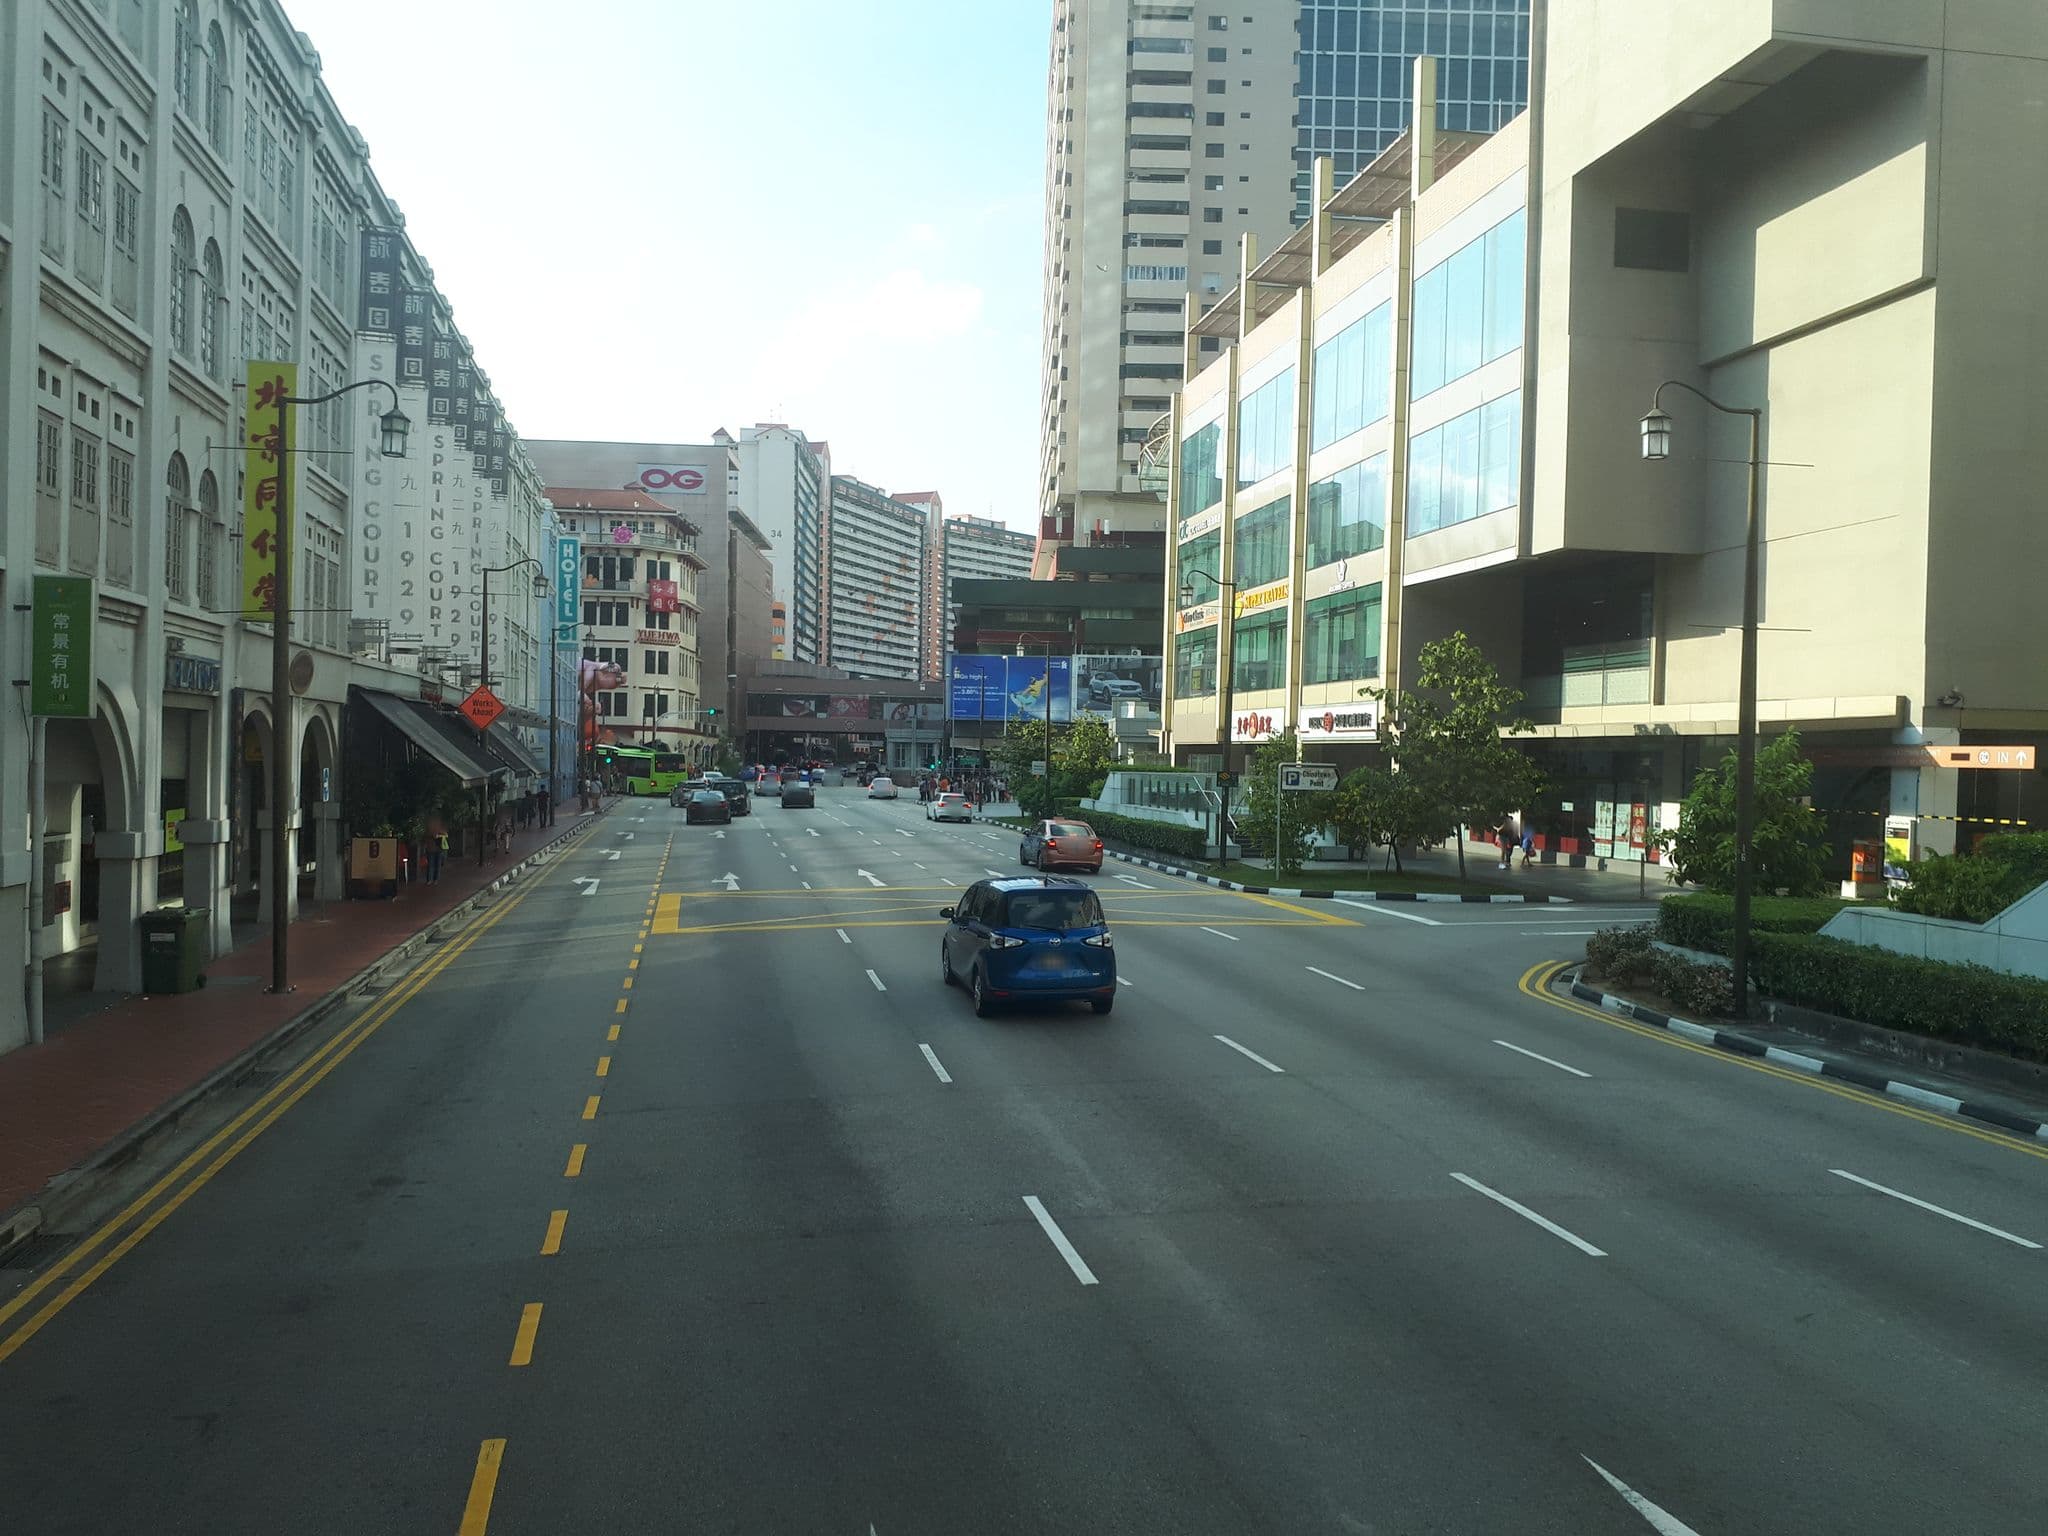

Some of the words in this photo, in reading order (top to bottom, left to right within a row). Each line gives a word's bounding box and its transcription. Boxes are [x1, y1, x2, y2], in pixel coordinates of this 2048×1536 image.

[365, 354, 383, 486] SPRING
[430, 434, 444, 540] SPRING
[640, 468, 704, 490] OG
[363, 502, 382, 609] COURT
[400, 520, 415, 626] 1929
[470, 486, 483, 576] SPRING
[770, 529, 782, 538] 34
[429, 551, 444, 638] COURT
[450, 560, 462, 648] 1929
[469, 584, 482, 658] COURT
[560, 543, 576, 617] HOTEL
[472, 698, 494, 707] Works
[1997, 751, 2009, 764] IN
